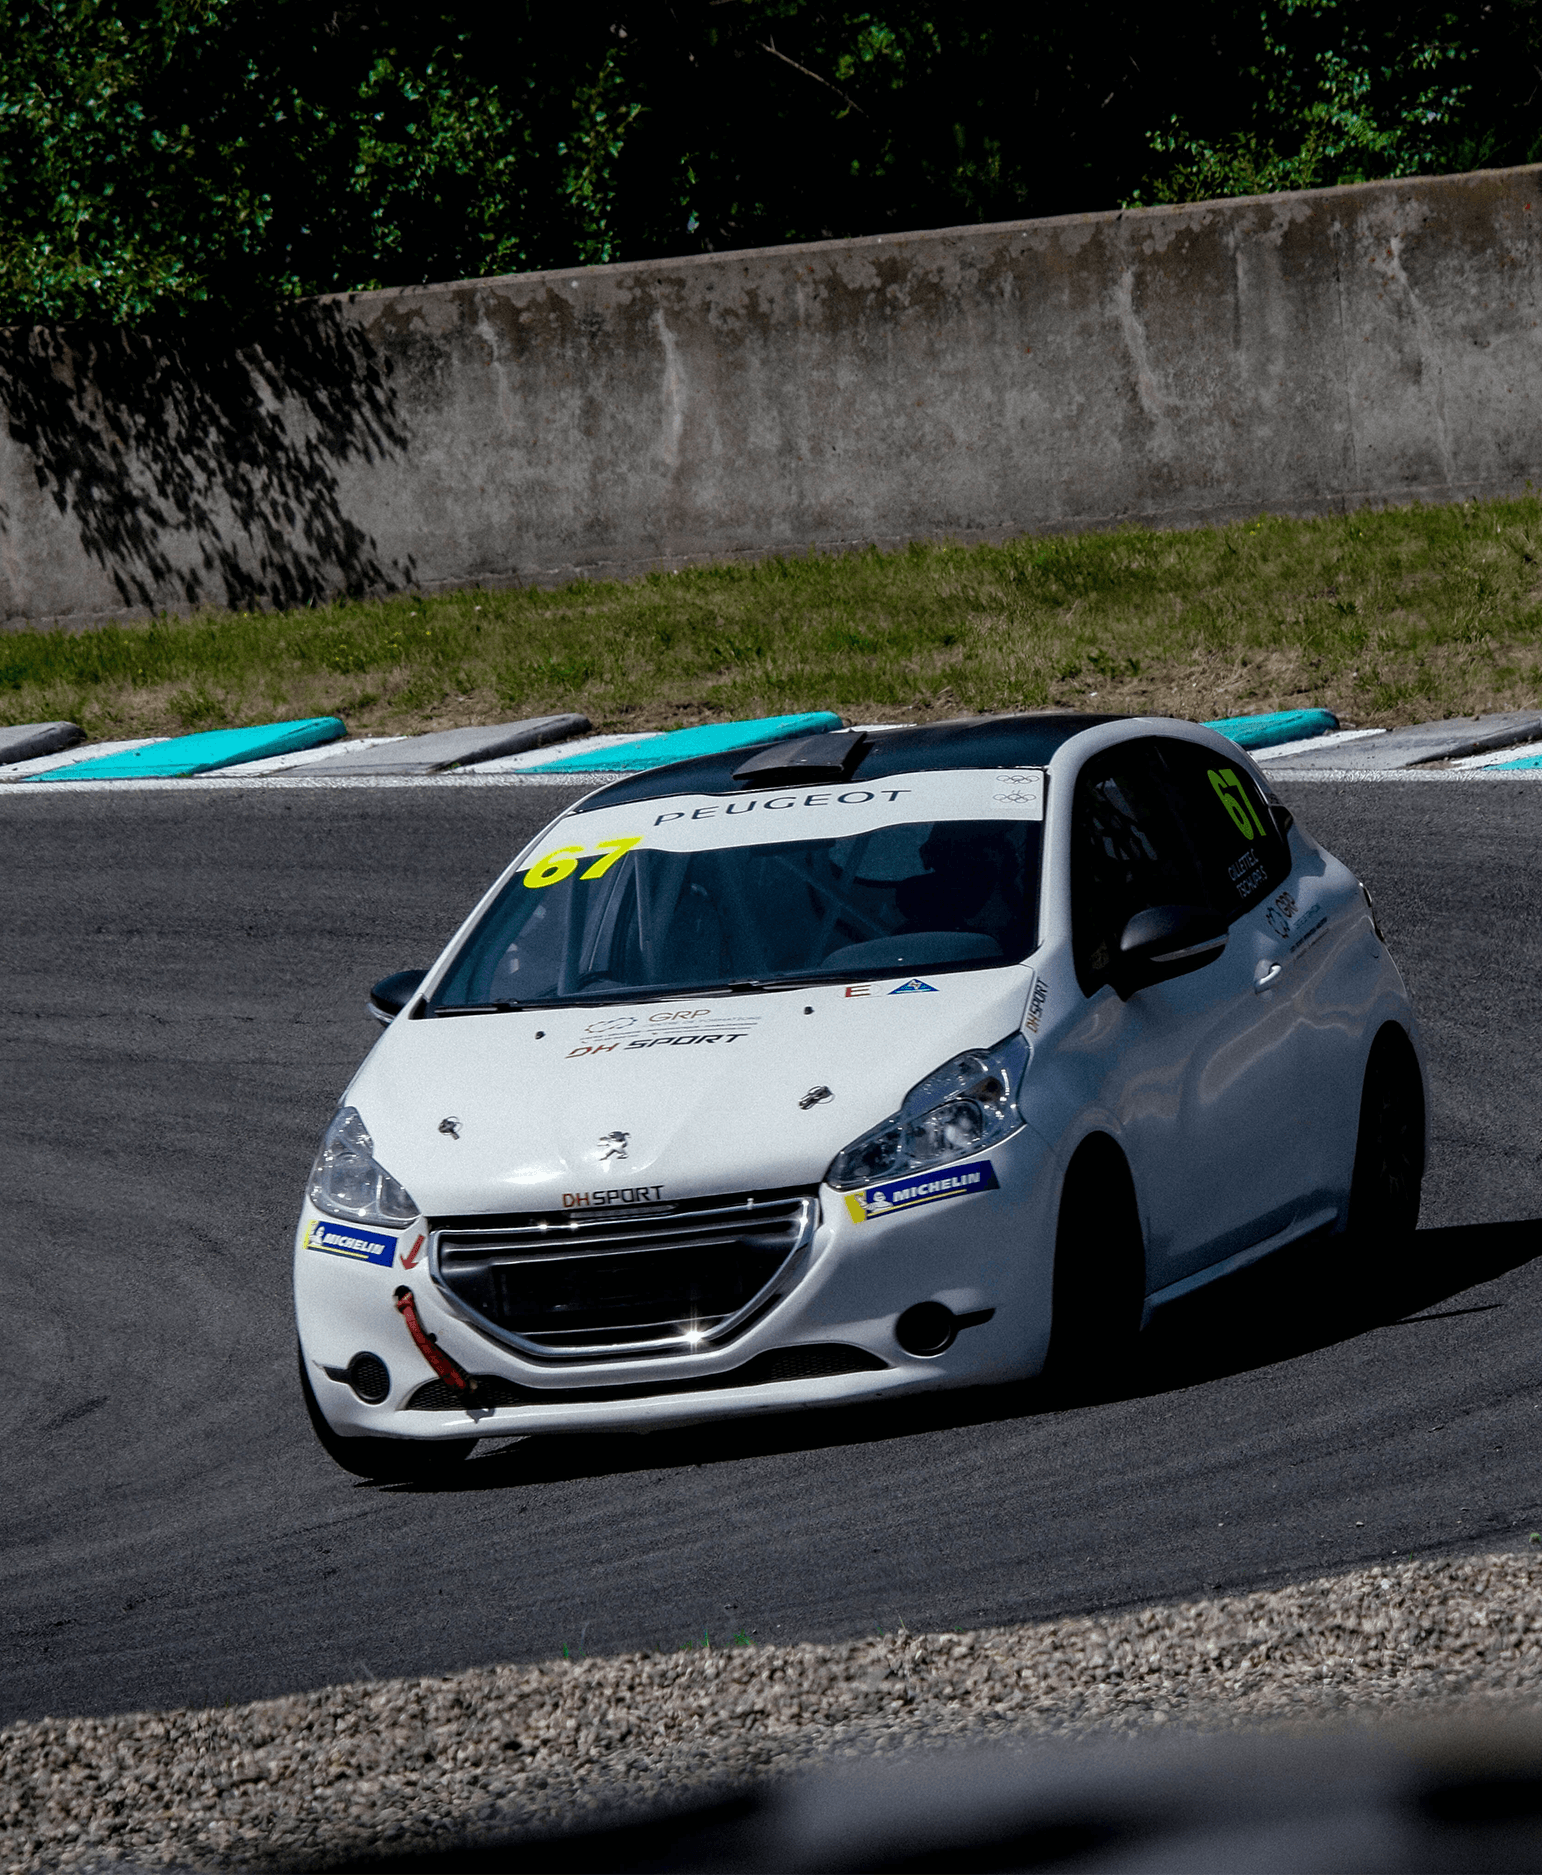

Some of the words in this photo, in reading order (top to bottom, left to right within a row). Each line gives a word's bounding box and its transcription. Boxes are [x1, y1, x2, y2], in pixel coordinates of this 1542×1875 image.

[653, 789, 912, 826] PEUGEOT
[1207, 769, 1267, 840] 67
[523, 835, 643, 889] 67
[1275, 891, 1298, 918] GRP
[845, 984, 871, 998] E
[649, 1009, 711, 1022] GRP
[623, 1033, 749, 1050] SPORT
[892, 1172, 981, 1203] MICHELIN
[322, 1232, 386, 1255] MICHELIN
